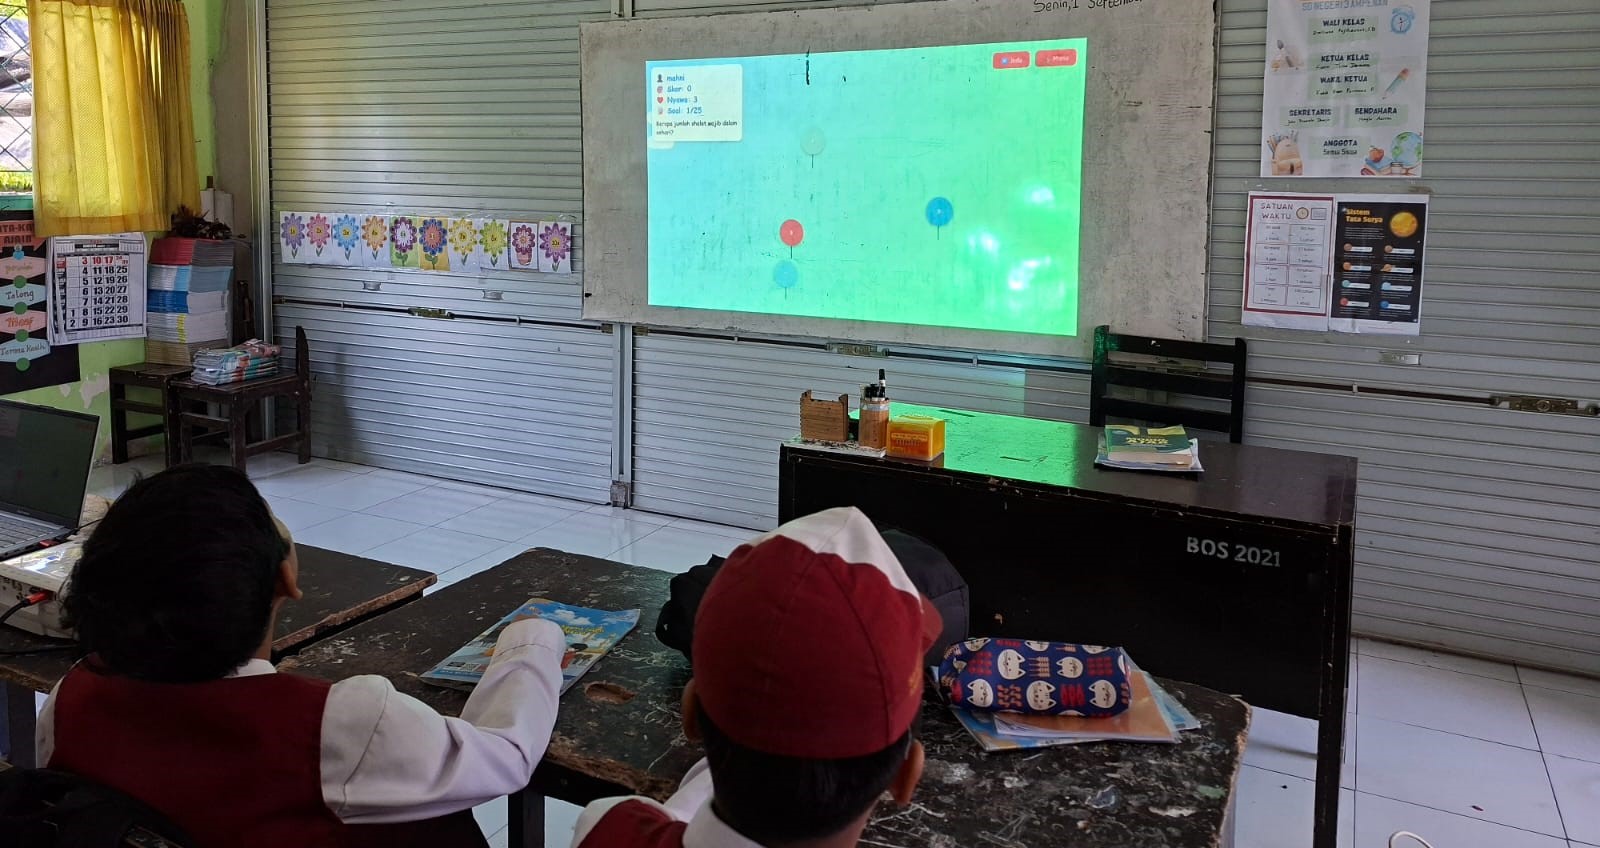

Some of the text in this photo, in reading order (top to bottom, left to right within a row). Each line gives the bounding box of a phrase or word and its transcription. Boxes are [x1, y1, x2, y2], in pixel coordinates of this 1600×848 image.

[5, 290, 34, 301] Tolong
[1186, 536, 1280, 567] BOS 2021
